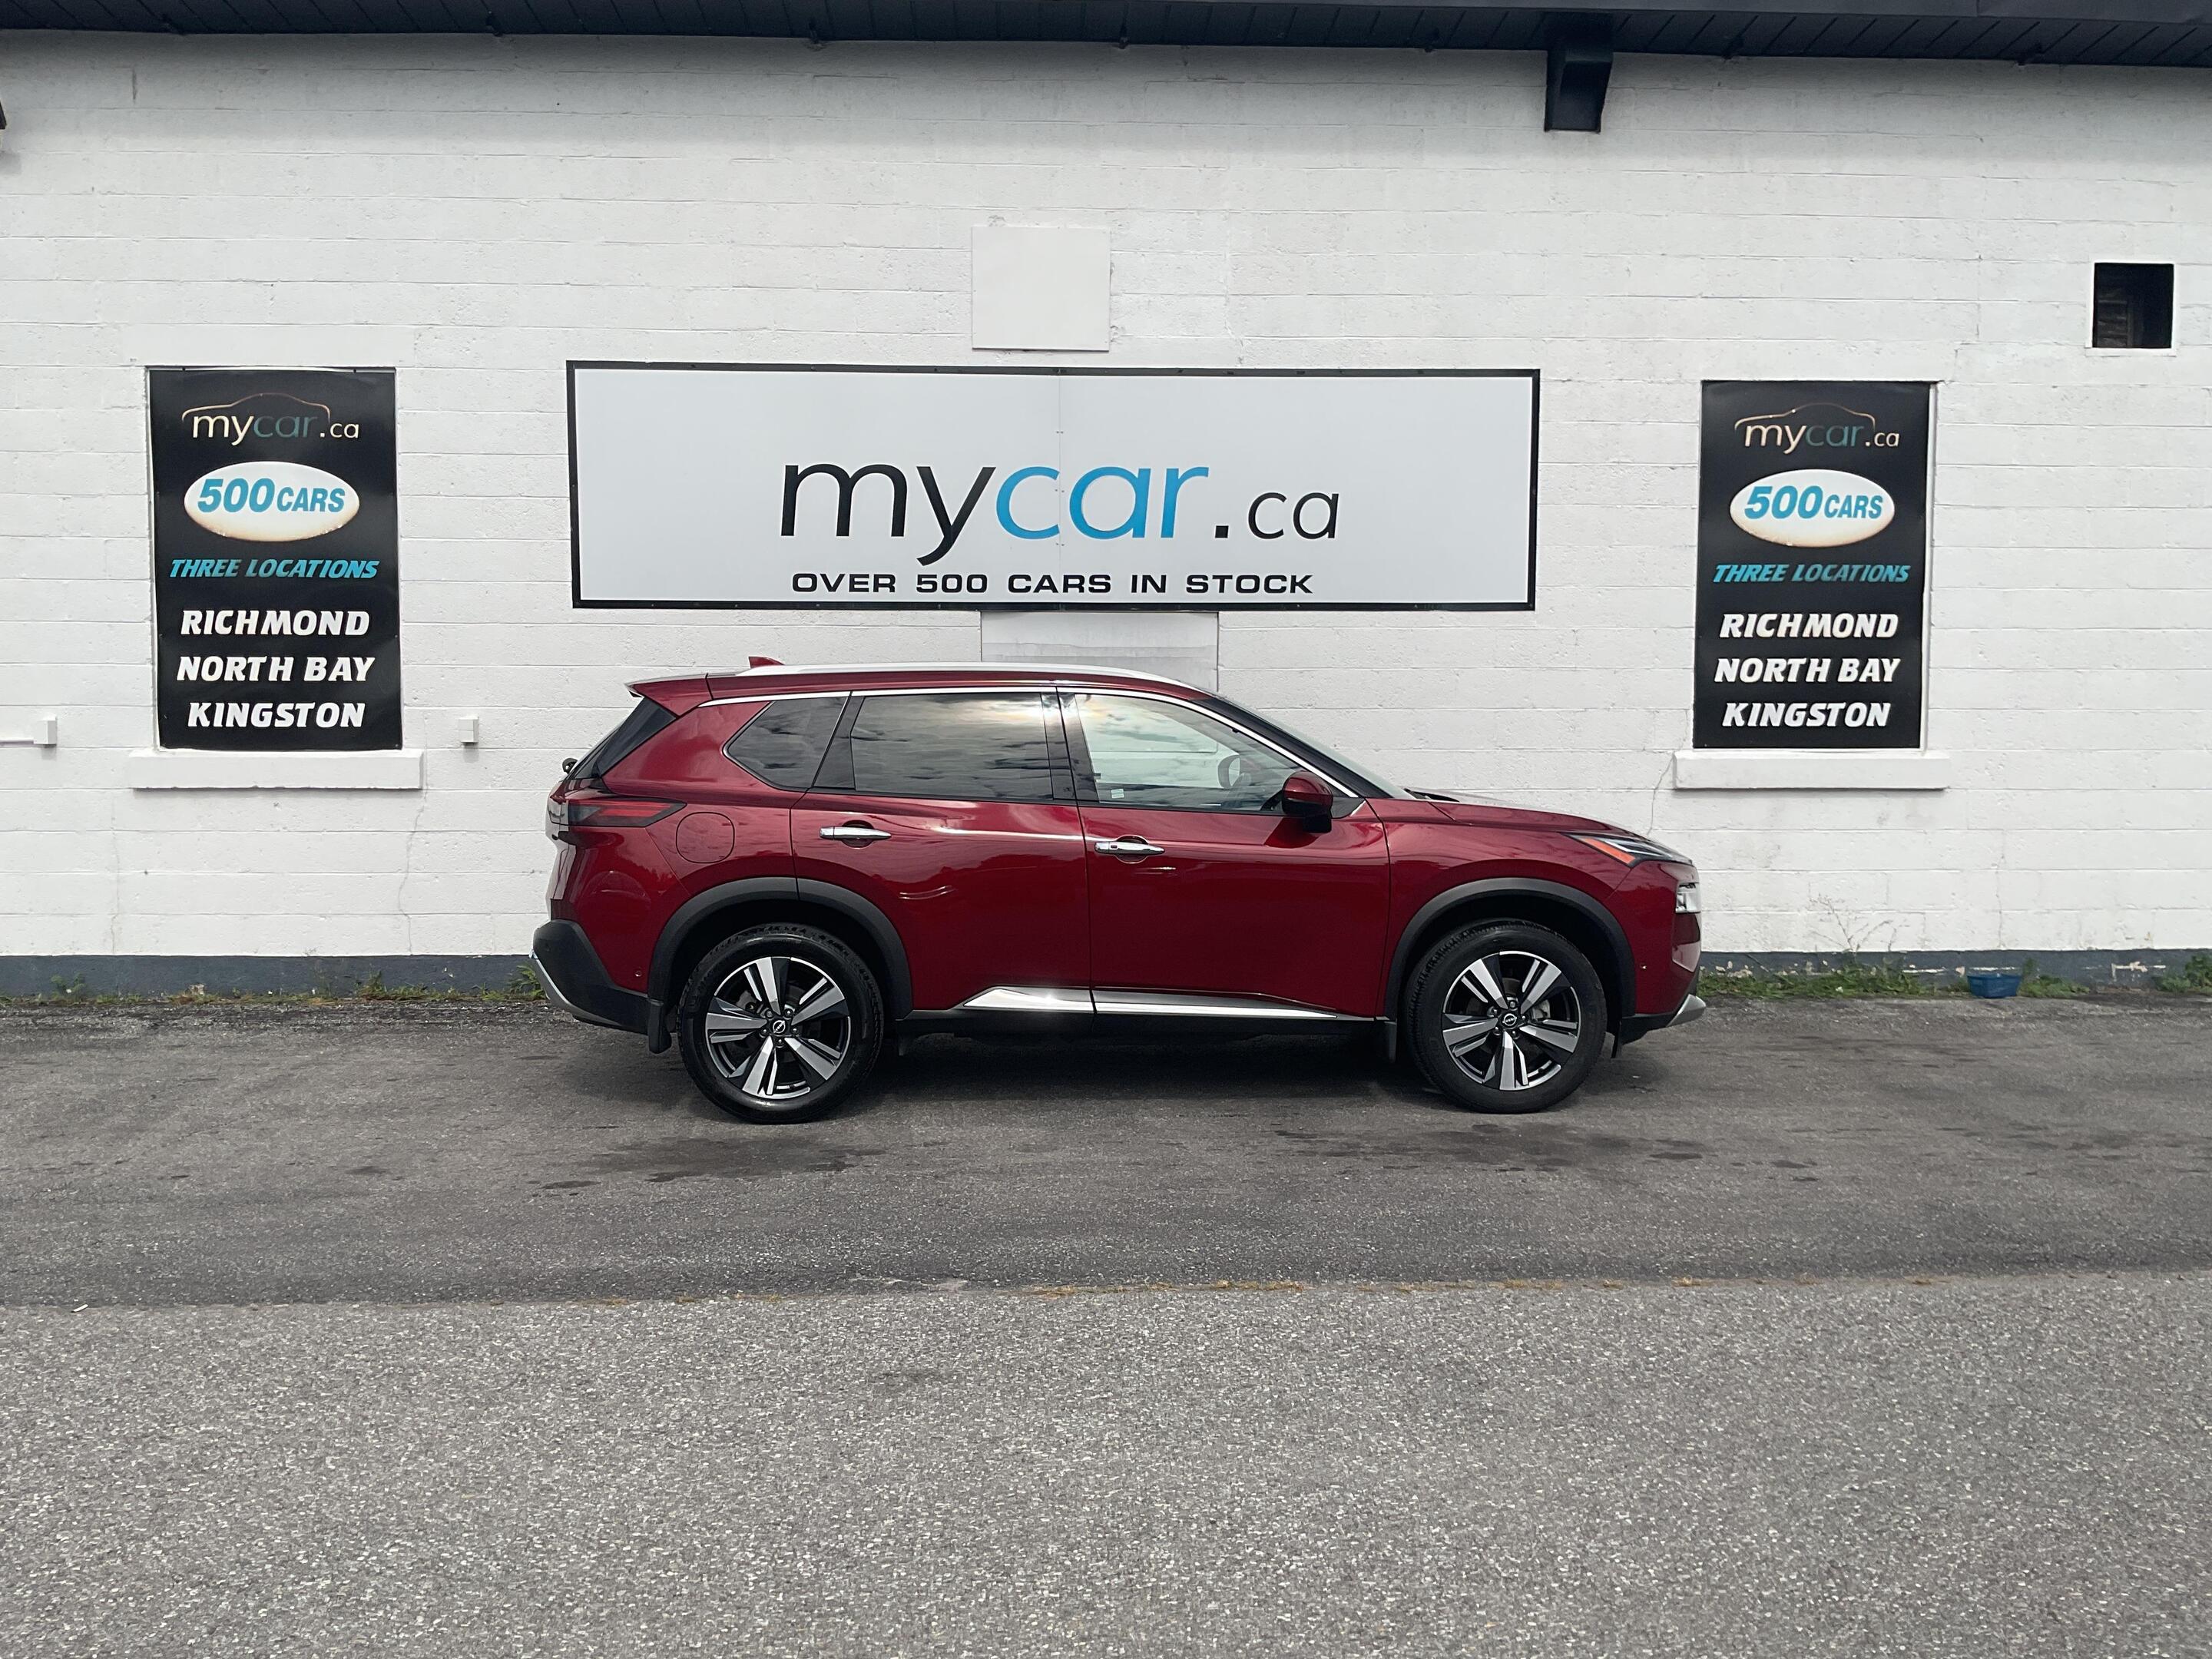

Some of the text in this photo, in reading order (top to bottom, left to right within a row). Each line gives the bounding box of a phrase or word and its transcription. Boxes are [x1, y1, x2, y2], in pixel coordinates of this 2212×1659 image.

[197, 478, 345, 514] 500 CARS
[1743, 485, 1883, 519] 500 CARS
[169, 559, 379, 579] THREE LOCATIONS
[1713, 564, 1911, 583] THREE LOCATIONS
[792, 573, 1313, 594] OVER 500 CARS IN STOCK
[180, 610, 370, 636] RICHMOND
[1719, 614, 1899, 638] RICHMOND
[177, 656, 376, 681] NORTH BAY
[1714, 657, 1900, 683] NORTH BAY
[187, 702, 366, 728] KINGSTON
[1722, 702, 1891, 727] KINGSTON
